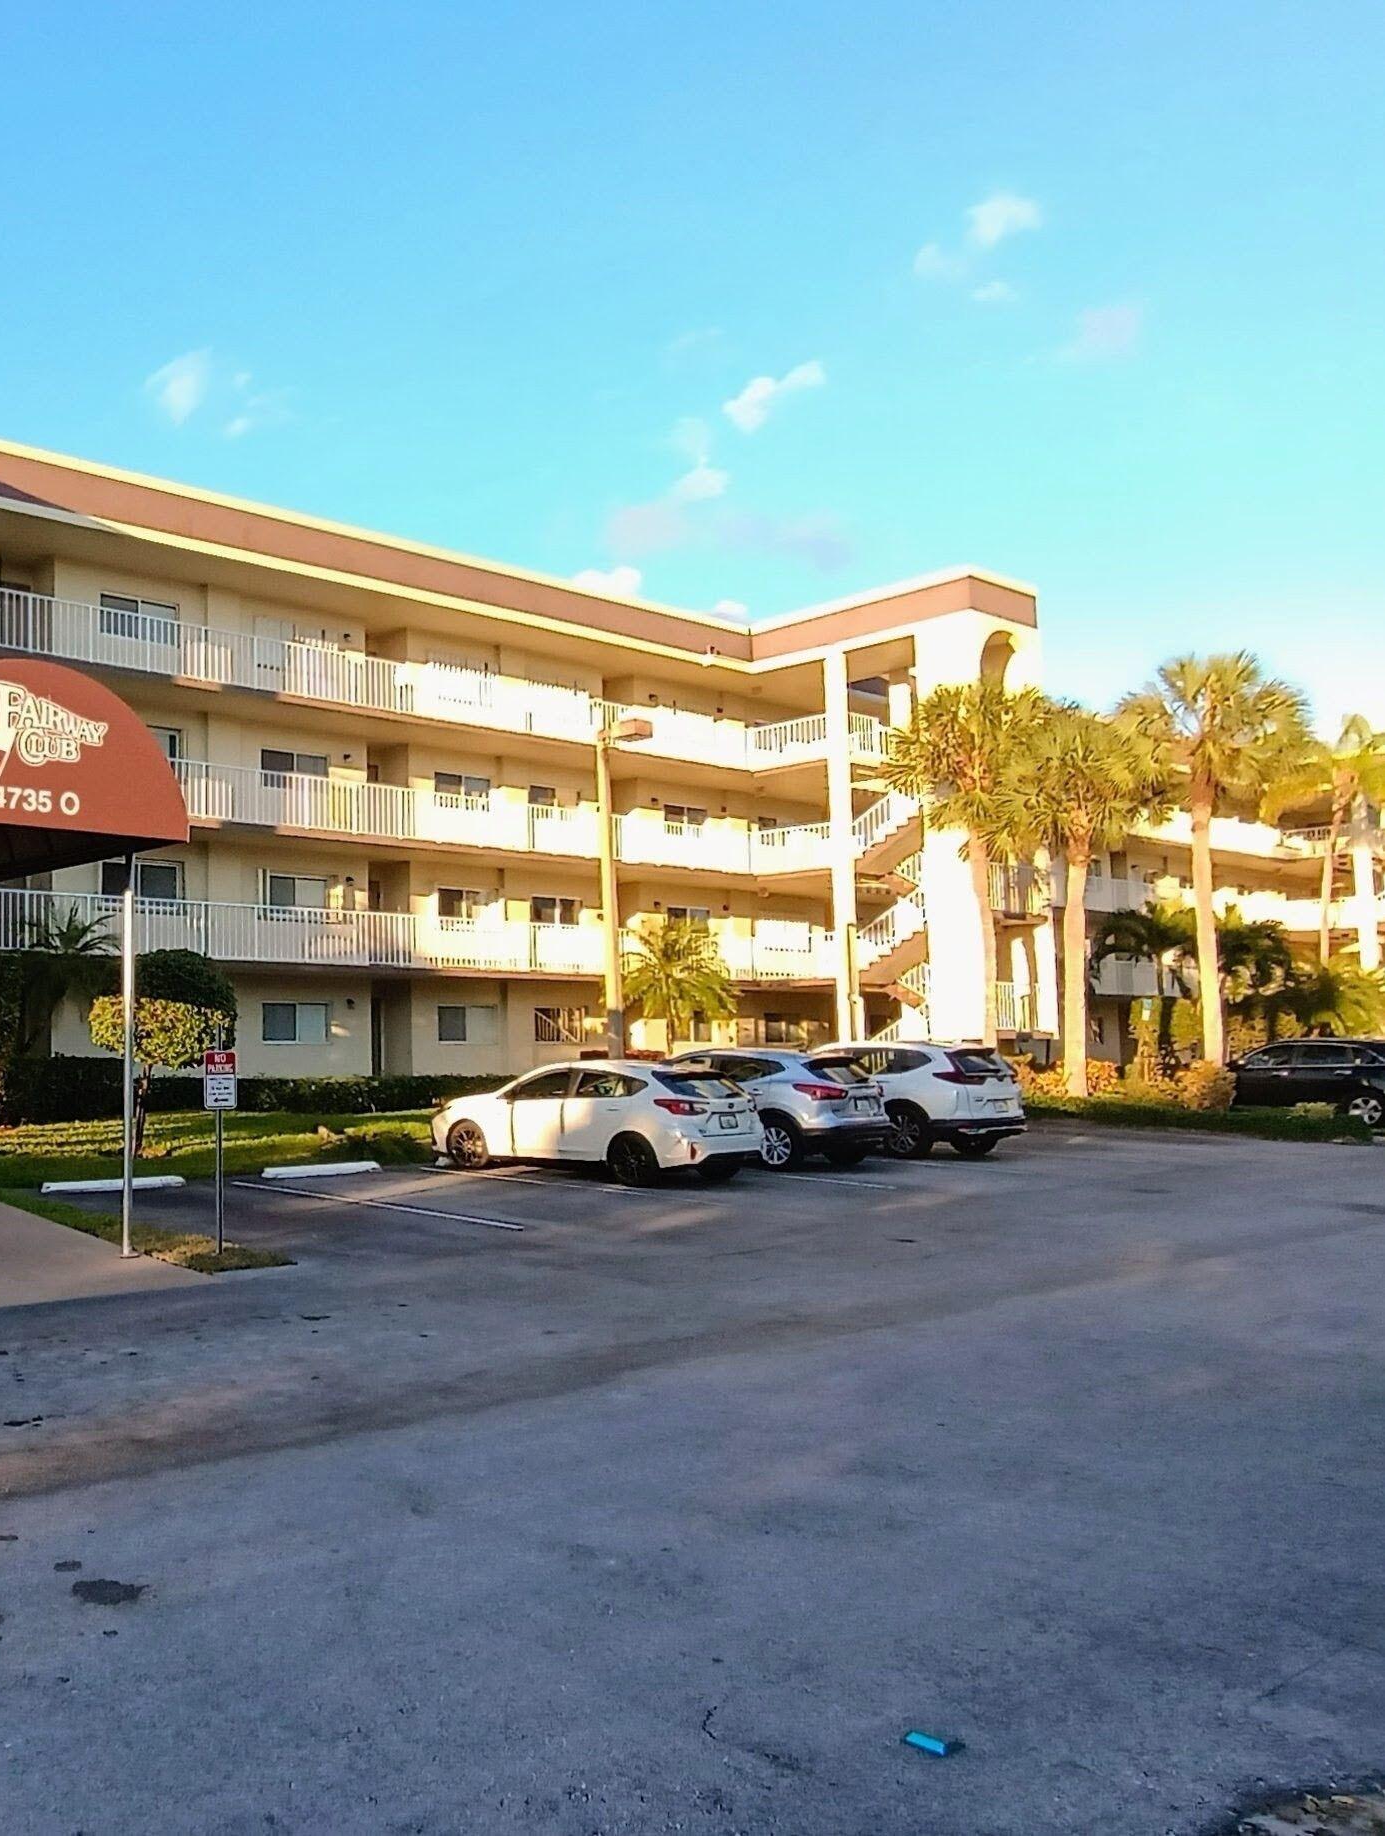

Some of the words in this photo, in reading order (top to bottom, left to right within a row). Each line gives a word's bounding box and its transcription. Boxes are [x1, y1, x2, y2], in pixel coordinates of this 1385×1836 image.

[17, 729, 80, 765] CLUB
[215, 1053, 226, 1063] NO
[207, 1064, 233, 1073] PARKING
